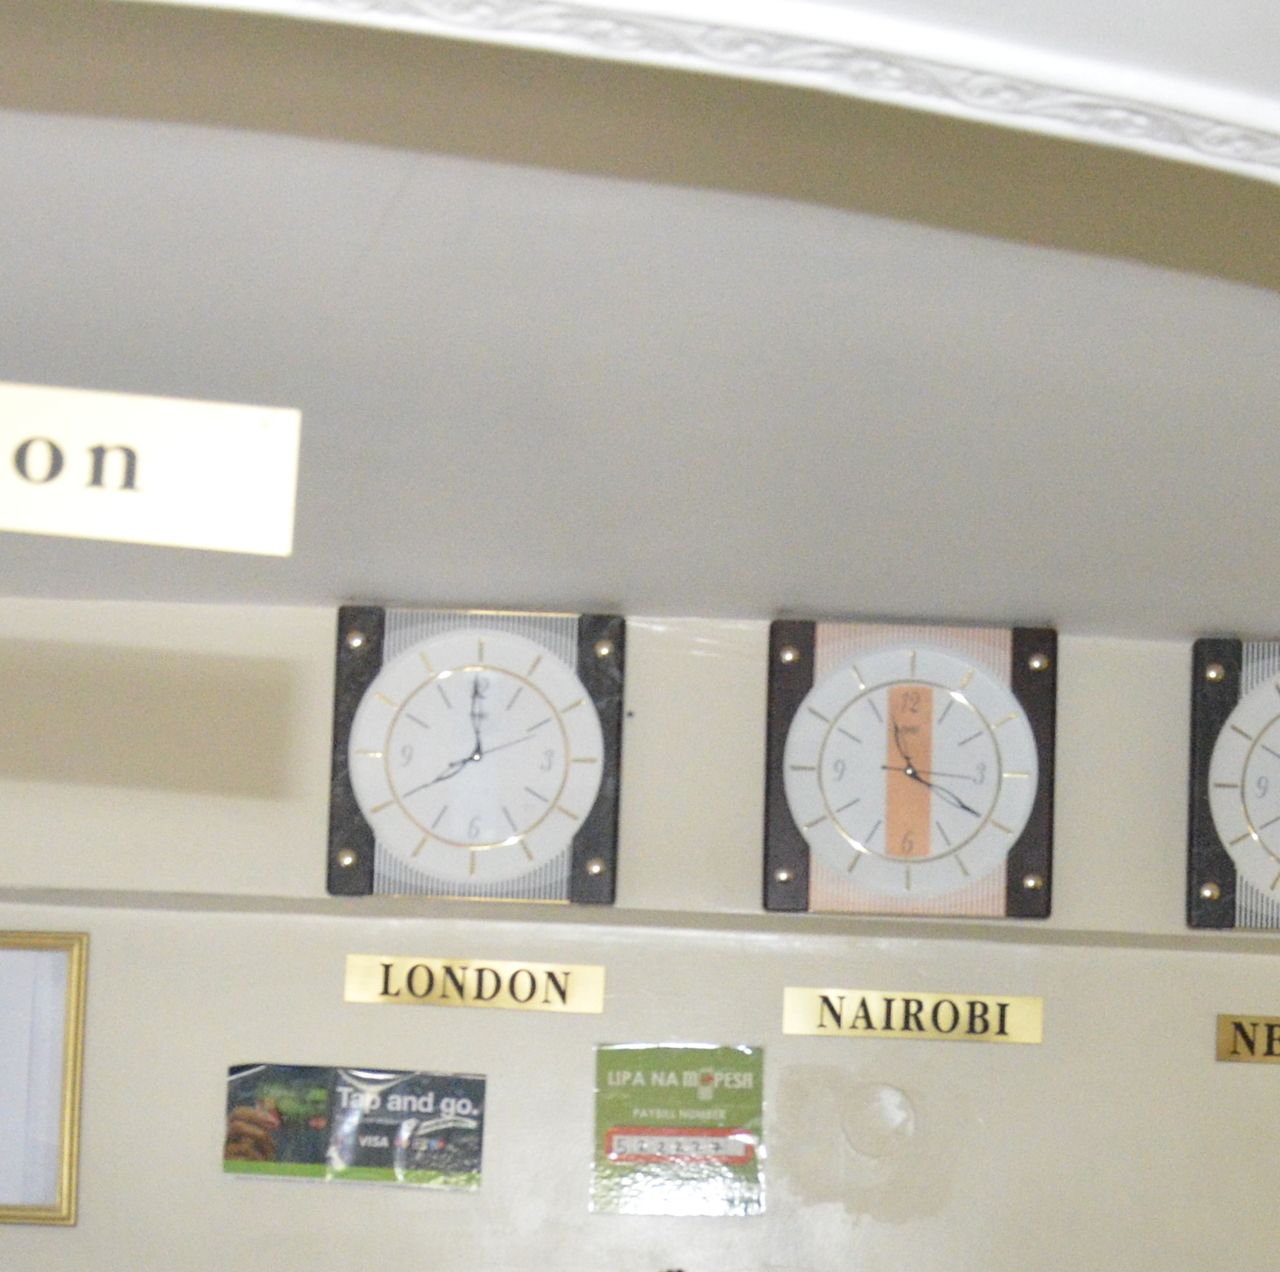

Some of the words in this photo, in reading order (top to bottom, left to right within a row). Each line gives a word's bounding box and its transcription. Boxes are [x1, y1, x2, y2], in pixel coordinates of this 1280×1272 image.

[401, 745, 413, 767] 9
[541, 749, 554, 771] 3
[833, 759, 846, 781] 9
[974, 762, 987, 785] 3
[1256, 776, 1269, 798] 9
[469, 815, 480, 838] 6
[901, 830, 914, 853] 6
[379, 963, 570, 1005] LONDON
[817, 995, 1010, 1036] NAIROBI
[608, 1071, 645, 1087] LIPA
[652, 1071, 679, 1087] NA
[336, 1086, 380, 1113] Tap
[387, 1091, 434, 1112] and
[440, 1096, 479, 1119] go.
[359, 1135, 389, 1149] VISA
